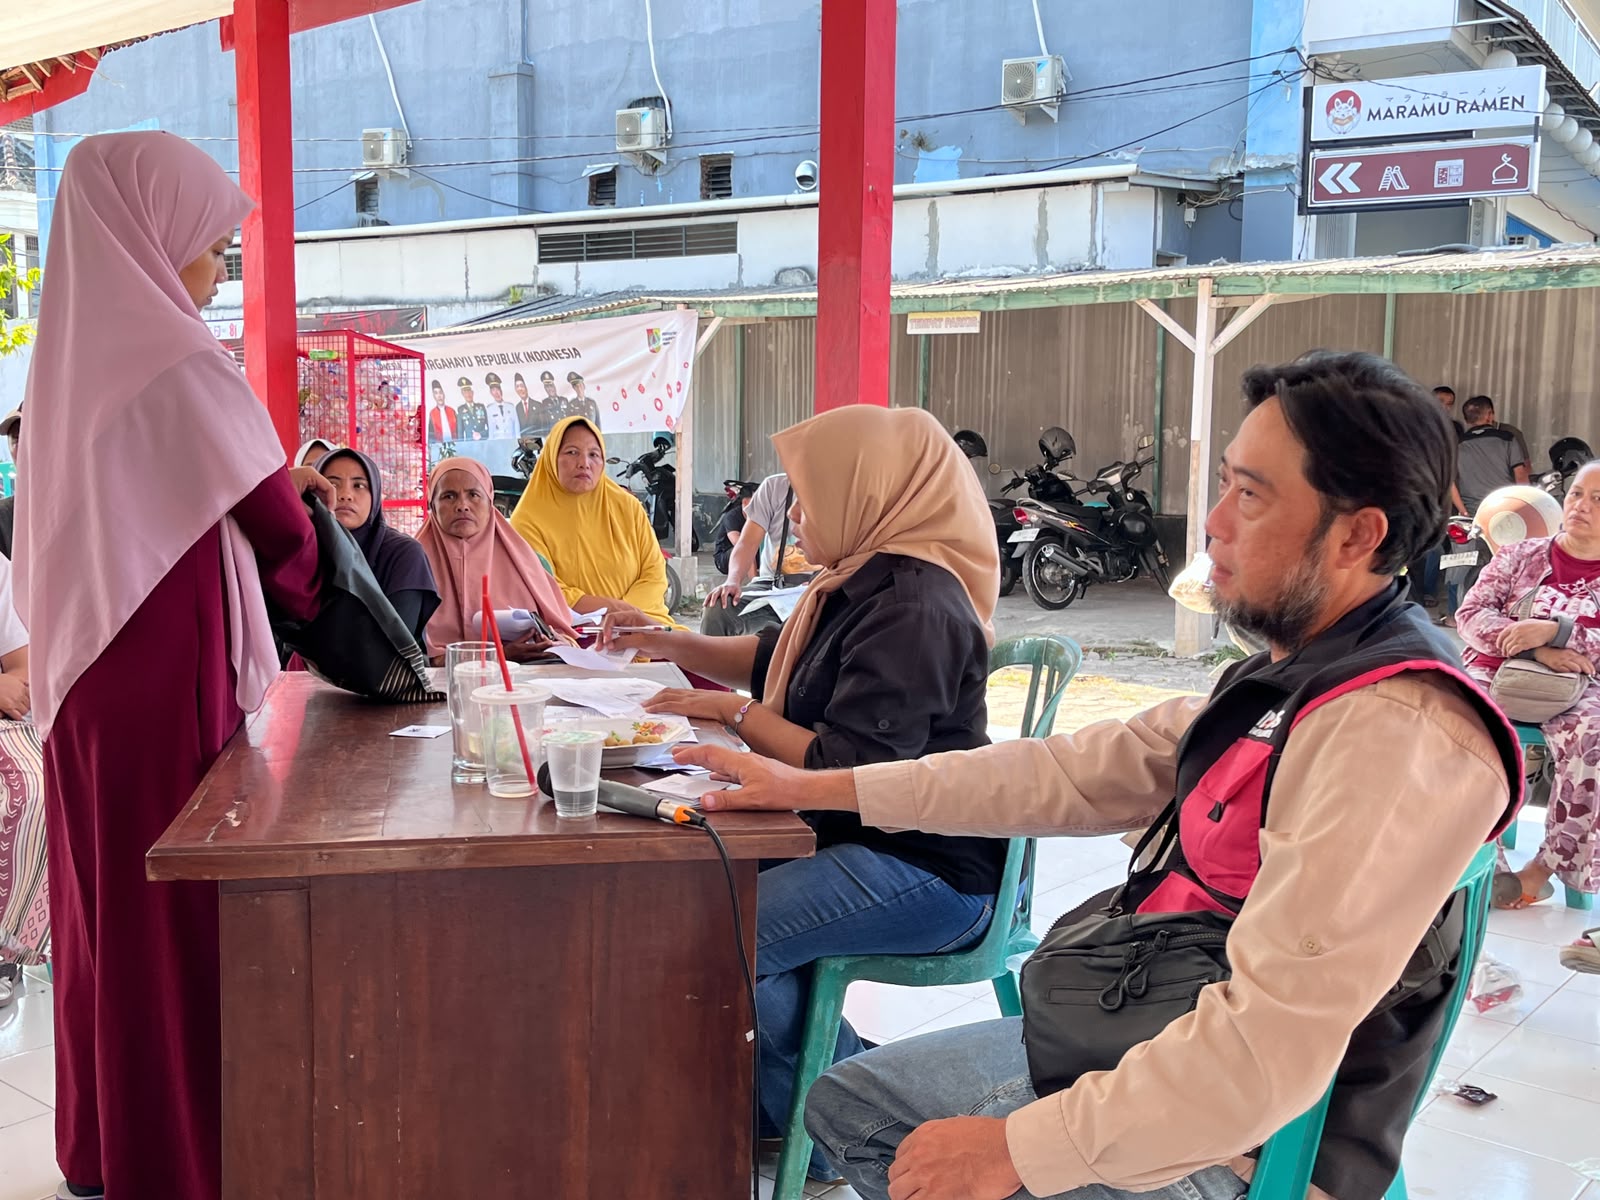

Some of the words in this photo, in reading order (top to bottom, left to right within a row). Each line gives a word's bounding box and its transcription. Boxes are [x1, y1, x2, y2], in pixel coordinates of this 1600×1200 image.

[1366, 101, 1450, 121] MARAMU
[1456, 95, 1525, 114] RAMEN
[473, 352, 524, 367] REPUBLIK
[524, 347, 582, 363] INDONESIA
